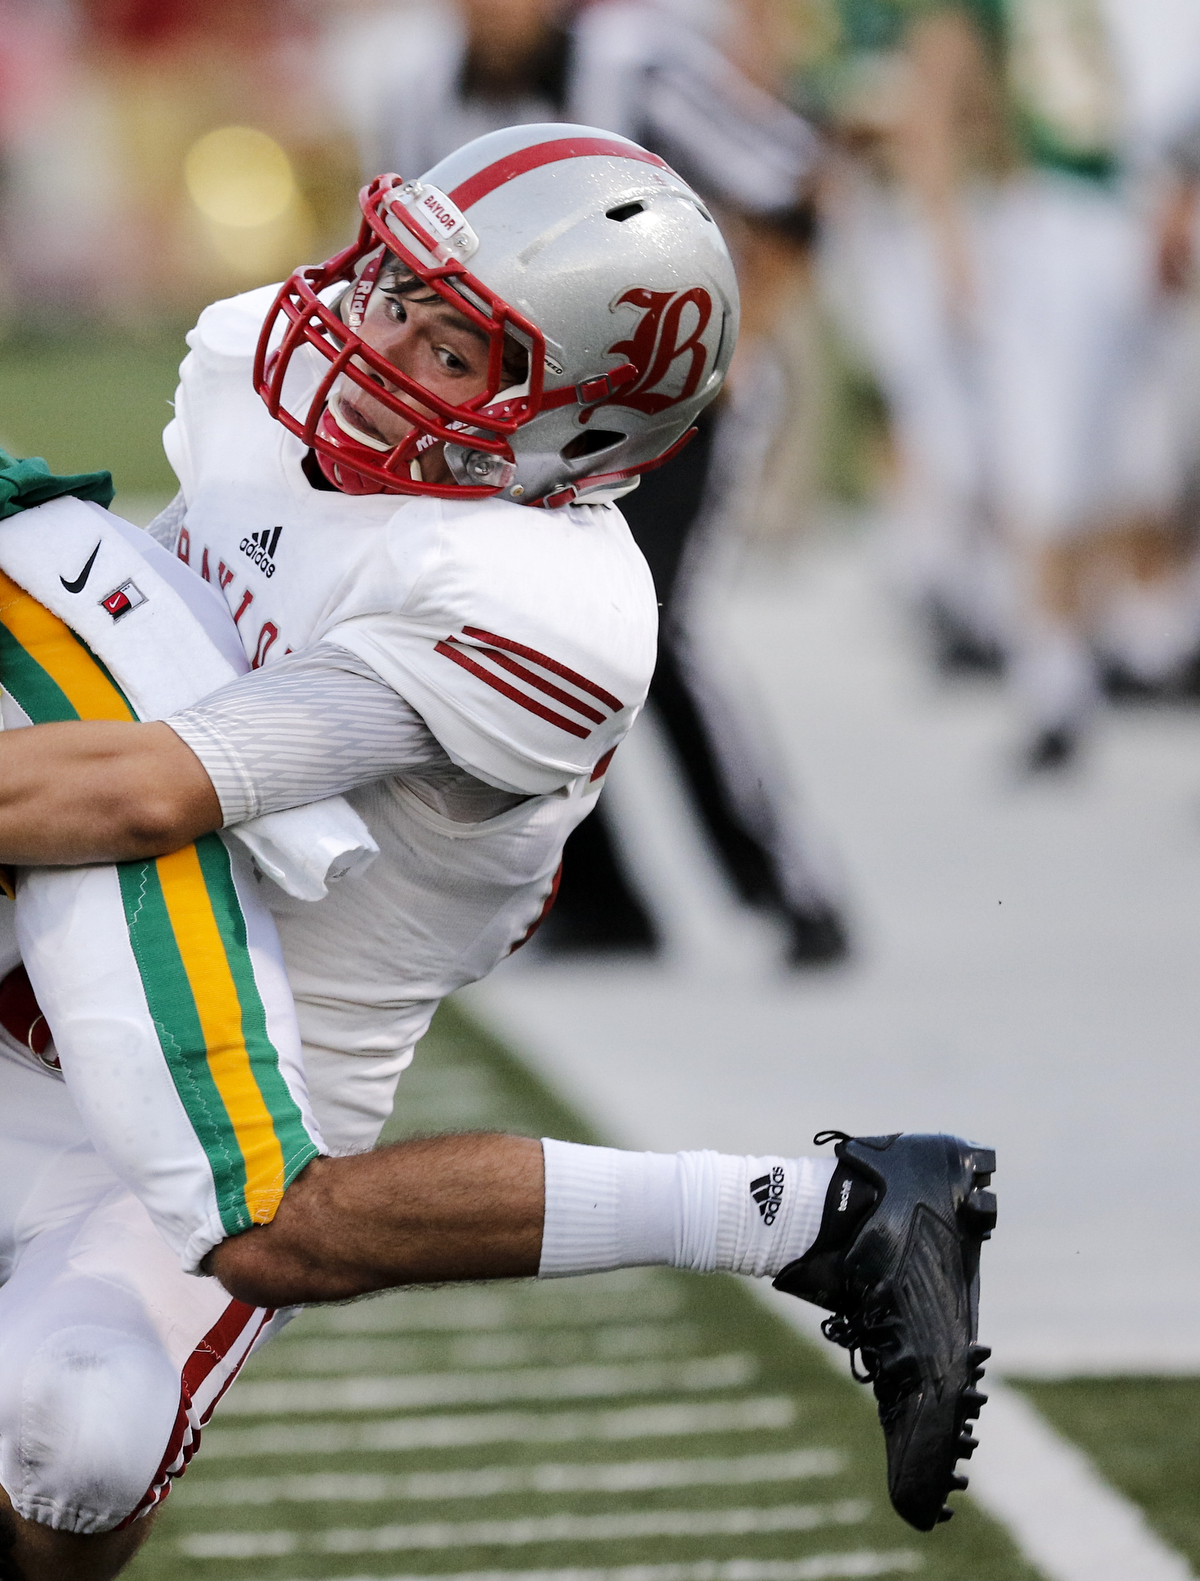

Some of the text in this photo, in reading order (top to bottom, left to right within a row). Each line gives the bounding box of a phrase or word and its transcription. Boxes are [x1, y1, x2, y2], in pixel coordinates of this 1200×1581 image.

[423, 195, 456, 231] BAYLOR
[578, 286, 713, 425] B
[239, 537, 276, 579] adidas
[763, 1166, 785, 1226] adidas
